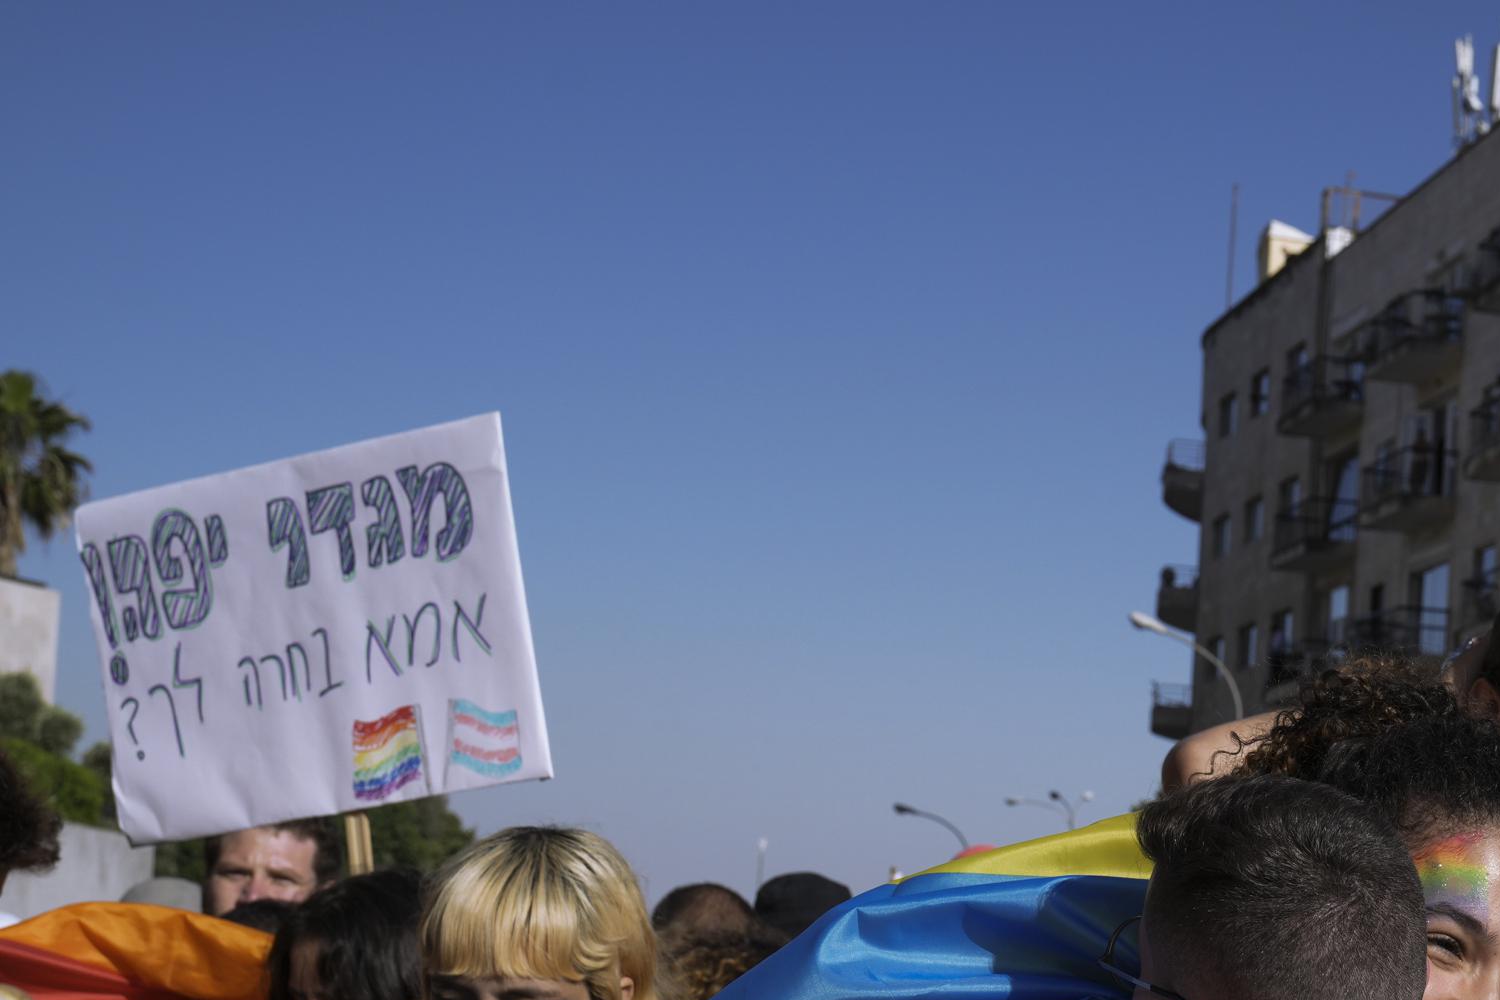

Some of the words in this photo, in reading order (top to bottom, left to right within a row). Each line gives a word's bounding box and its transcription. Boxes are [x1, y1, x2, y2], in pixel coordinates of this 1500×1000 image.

[237, 627, 344, 711] בחרה
[365, 592, 493, 684] אמא
[119, 641, 204, 762] לך?
